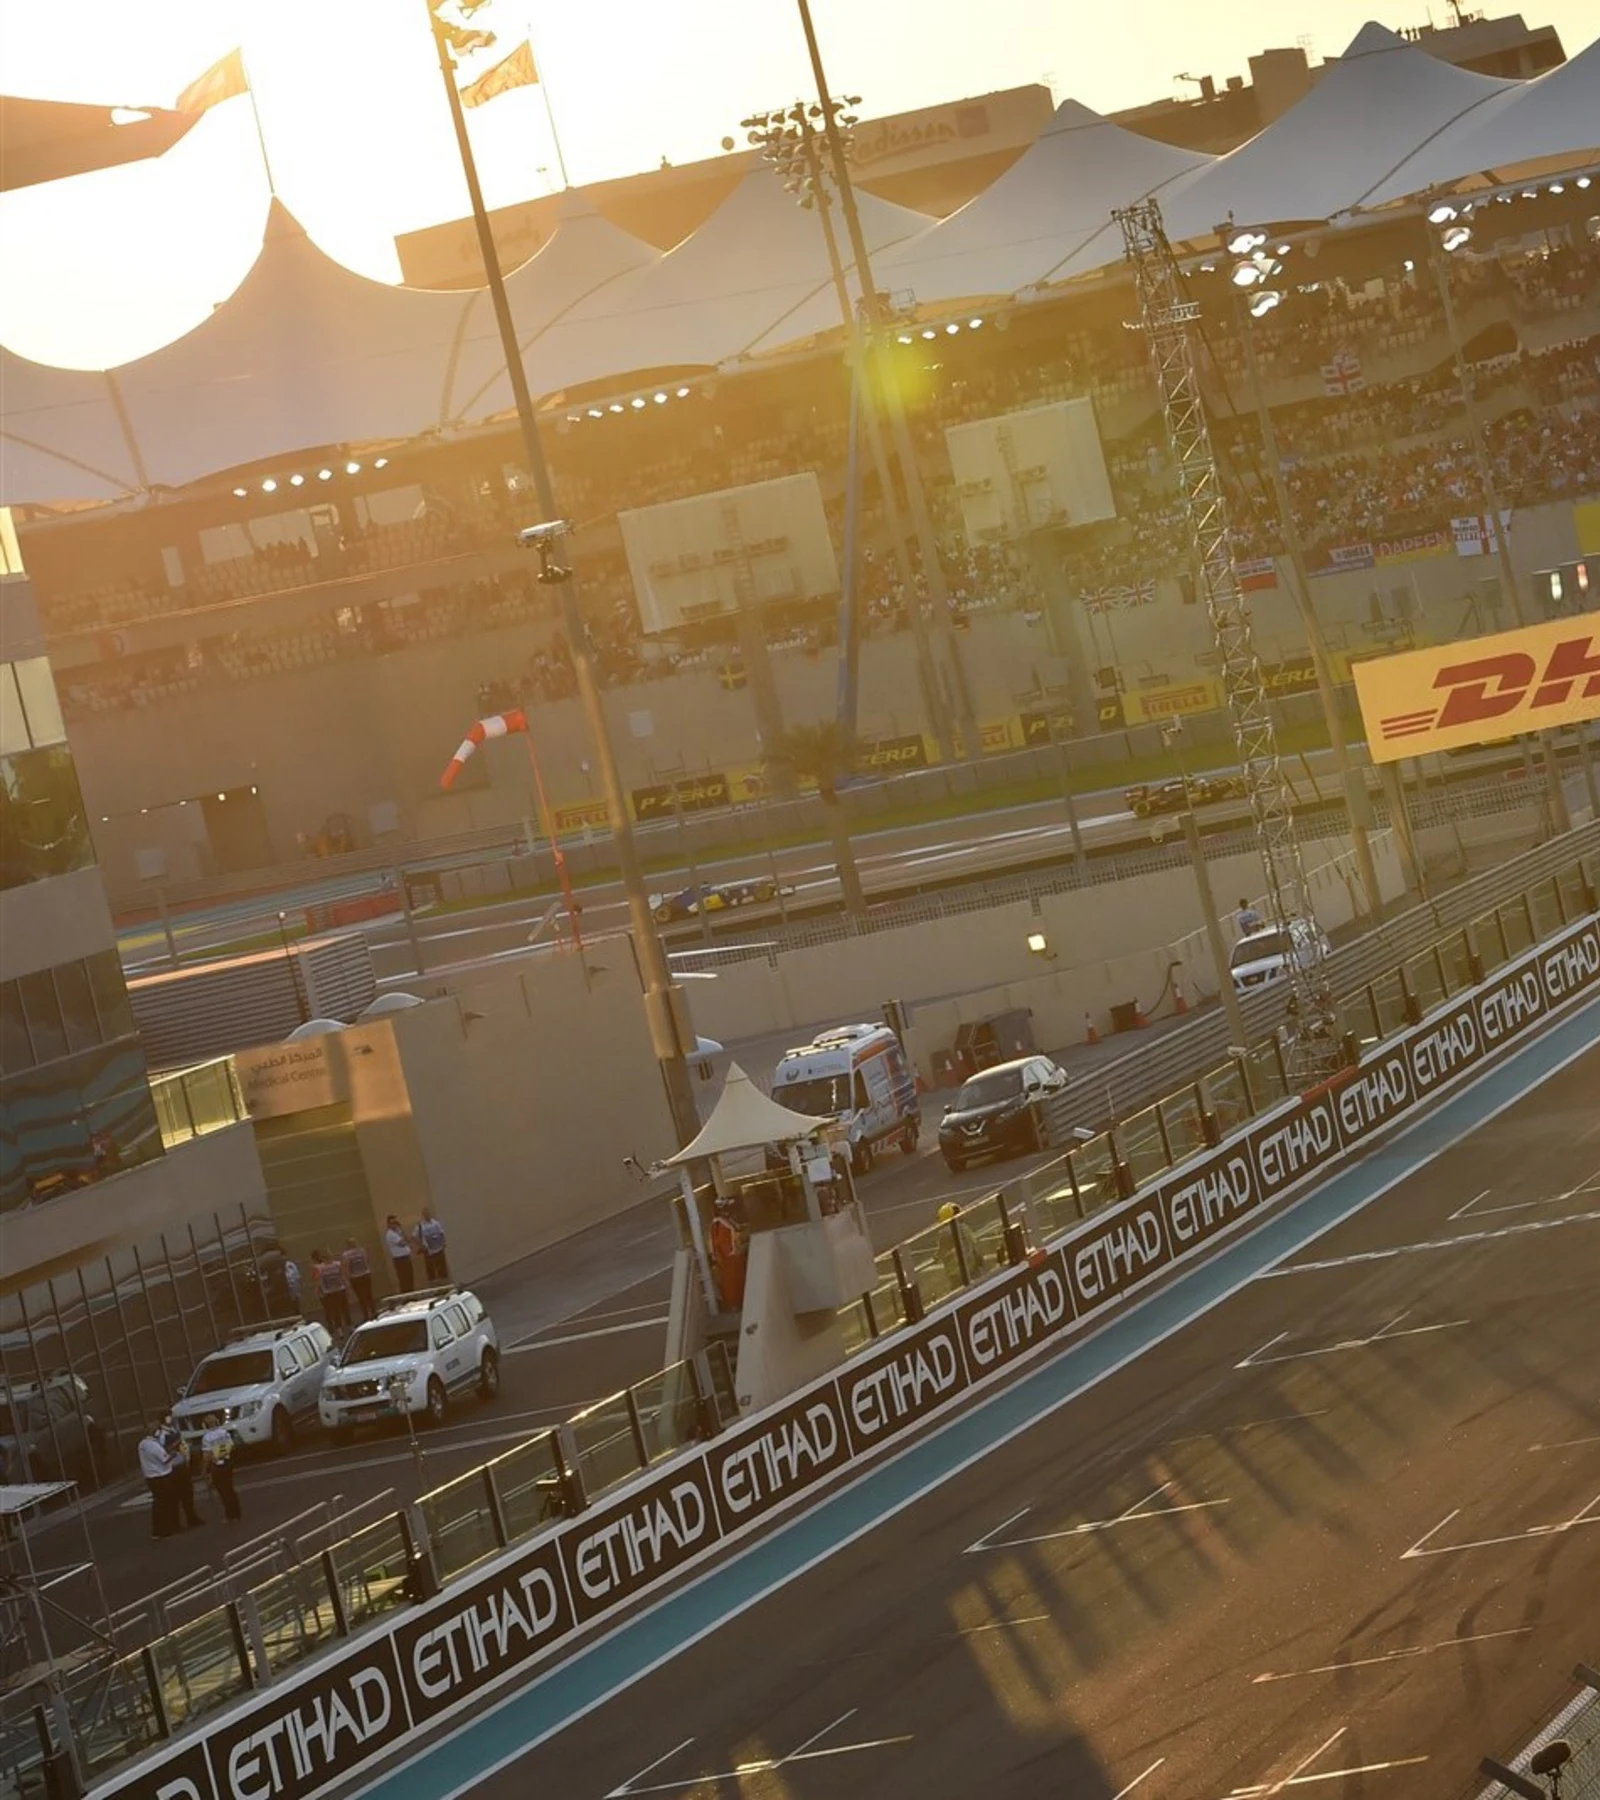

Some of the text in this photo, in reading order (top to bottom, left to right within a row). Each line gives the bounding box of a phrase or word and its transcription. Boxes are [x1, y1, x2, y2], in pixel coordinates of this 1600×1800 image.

[1480, 971, 1540, 1040] ETIHAD
[1545, 933, 1600, 997] ETIHAD
[1413, 1012, 1476, 1085] ETIHAD
[1340, 1059, 1407, 1134] ETIHAD
[1258, 1105, 1332, 1185] ETIHAD
[1171, 1157, 1251, 1240] ETIHAD
[1074, 1214, 1162, 1300] ETIHAD
[968, 1269, 1065, 1365] ETIHAD
[851, 1335, 957, 1435] ETIHAD
[721, 1402, 838, 1514] ETIHAD
[576, 1481, 706, 1600] ETIHAD
[412, 1567, 558, 1699] ETIHAD
[228, 1666, 392, 1800] ETIHAD
